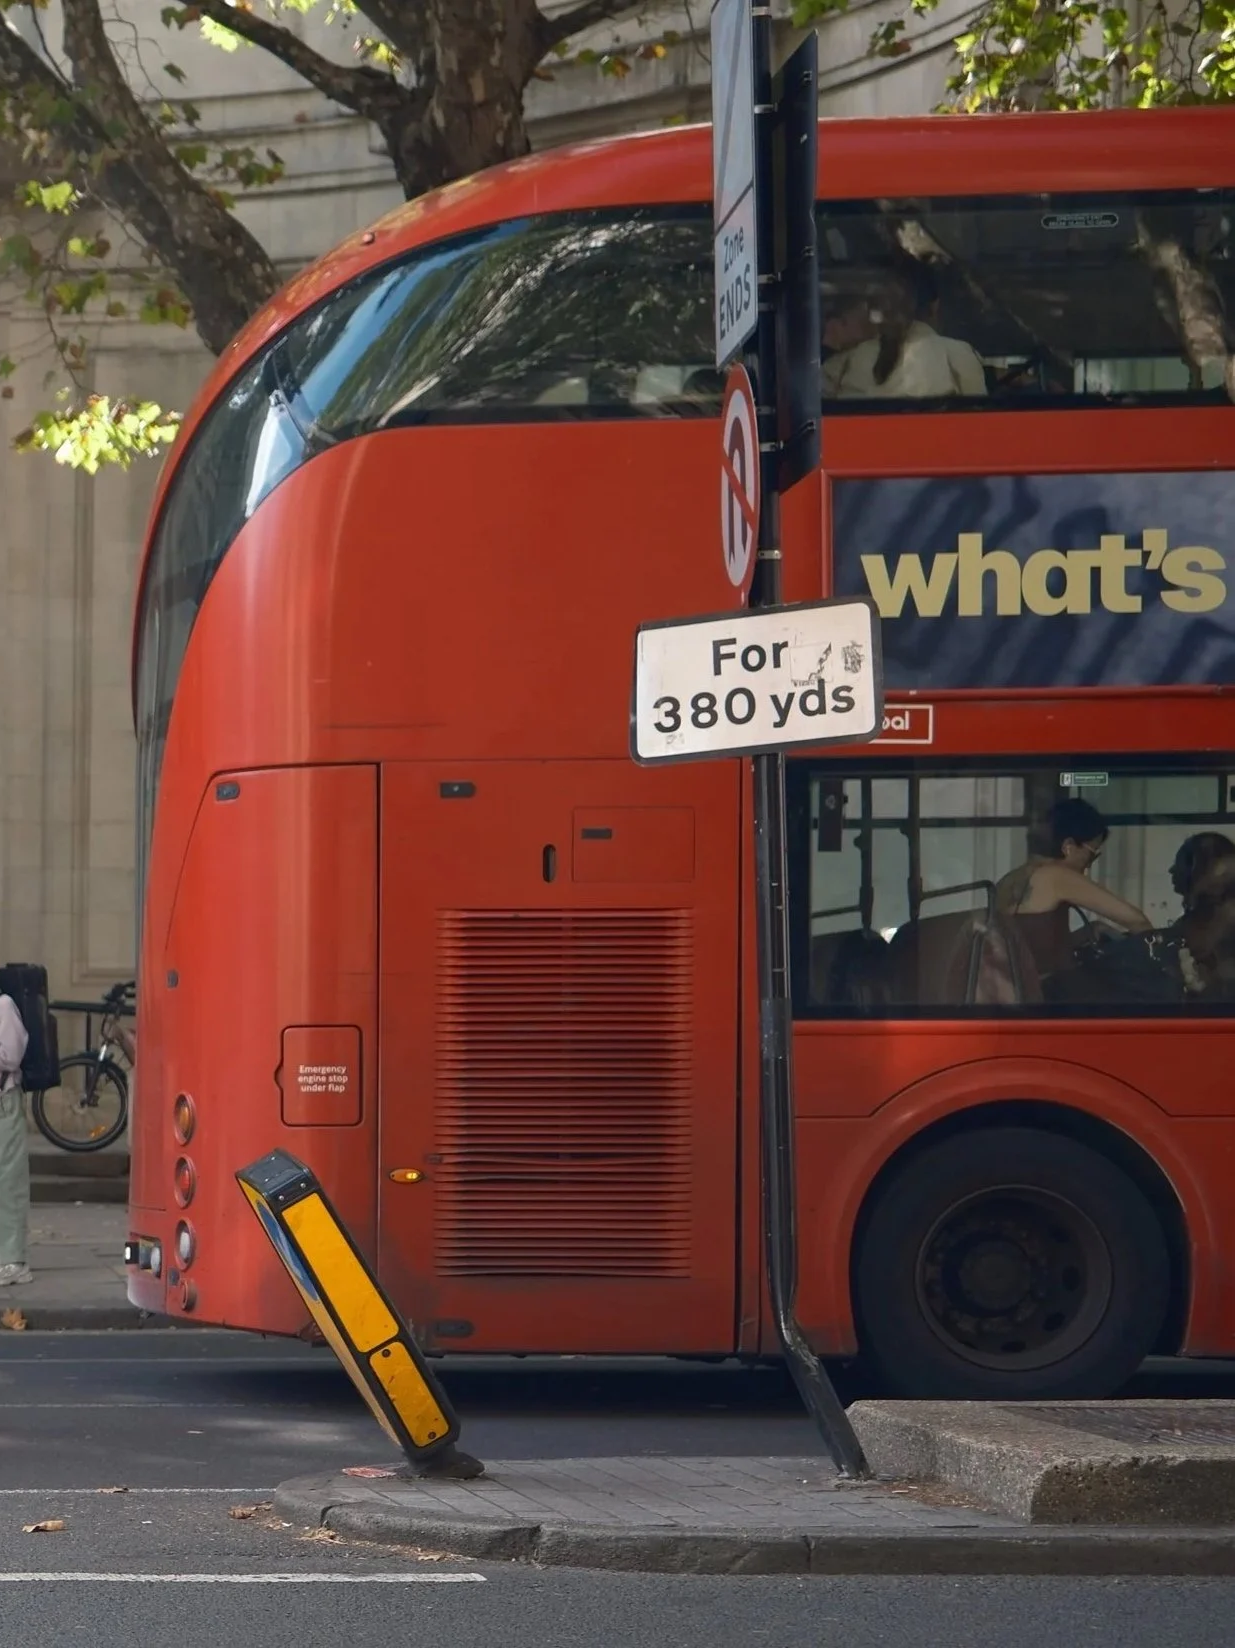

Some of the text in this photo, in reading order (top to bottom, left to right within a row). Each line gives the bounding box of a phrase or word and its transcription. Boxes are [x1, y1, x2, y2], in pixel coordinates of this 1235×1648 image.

[724, 226, 744, 273] Zone
[719, 263, 751, 340] ENDS
[860, 528, 1227, 618] what's
[712, 637, 790, 677] For
[653, 678, 856, 733] 380 yds
[297, 1074, 349, 1085] engine stop
[299, 1064, 347, 1075] Emergency
[300, 1083, 346, 1094] under flap
